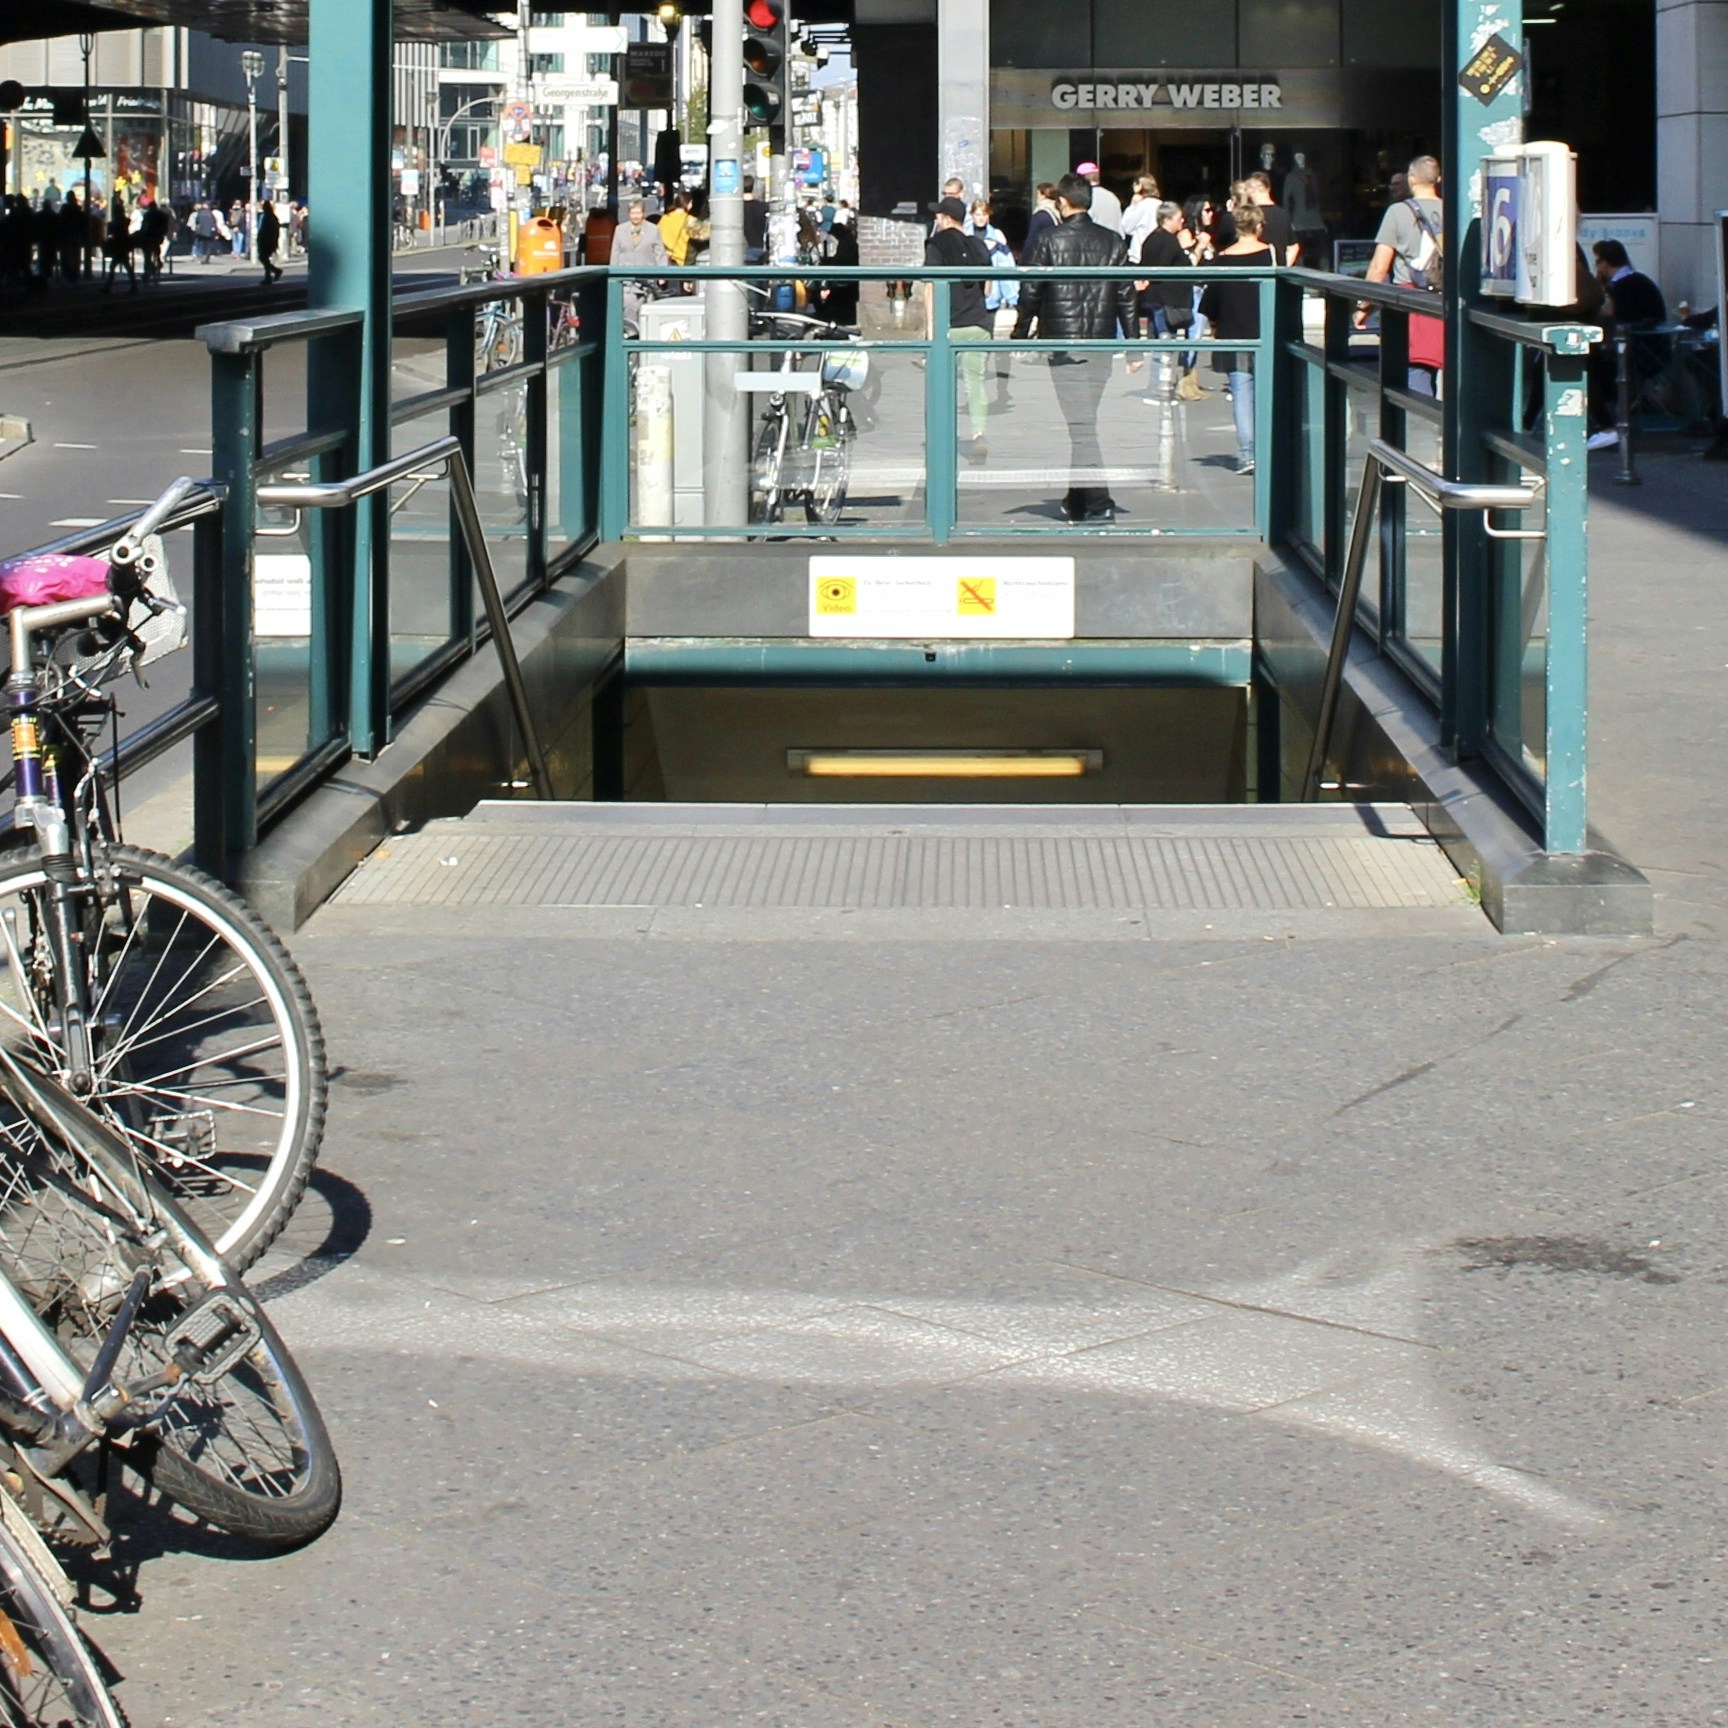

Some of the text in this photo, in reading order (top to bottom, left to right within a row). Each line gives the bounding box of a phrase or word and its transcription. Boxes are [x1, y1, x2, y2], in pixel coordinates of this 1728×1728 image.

[542, 87, 609, 100] Georgenstraße
[1052, 84, 1282, 109] GERRY WEBER
[823, 603, 852, 613] Video
